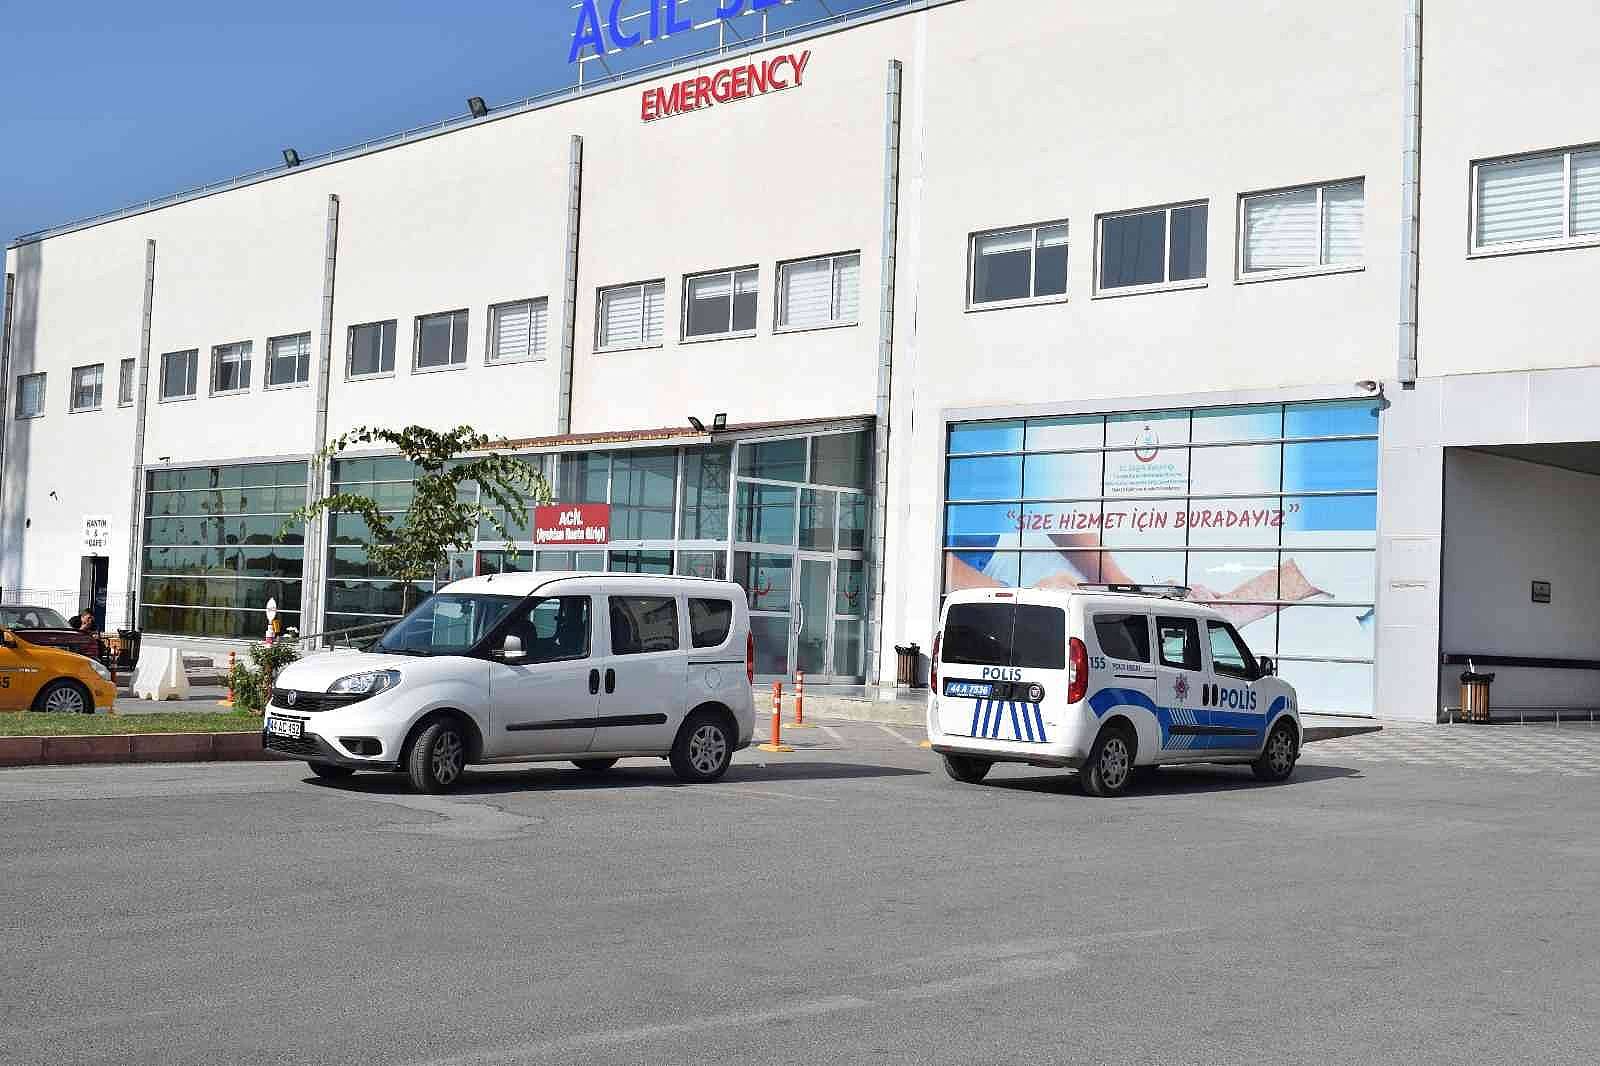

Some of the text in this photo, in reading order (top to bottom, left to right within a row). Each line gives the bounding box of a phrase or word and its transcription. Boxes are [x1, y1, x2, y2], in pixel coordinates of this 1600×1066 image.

[641, 50, 811, 121] EMERGENCY
[1059, 510, 1128, 530] HİZMET
[1131, 507, 1168, 532] İÇİN
[982, 667, 1022, 681] POLİS
[1089, 657, 1106, 670] 155
[1220, 685, 1257, 711] POLİS
